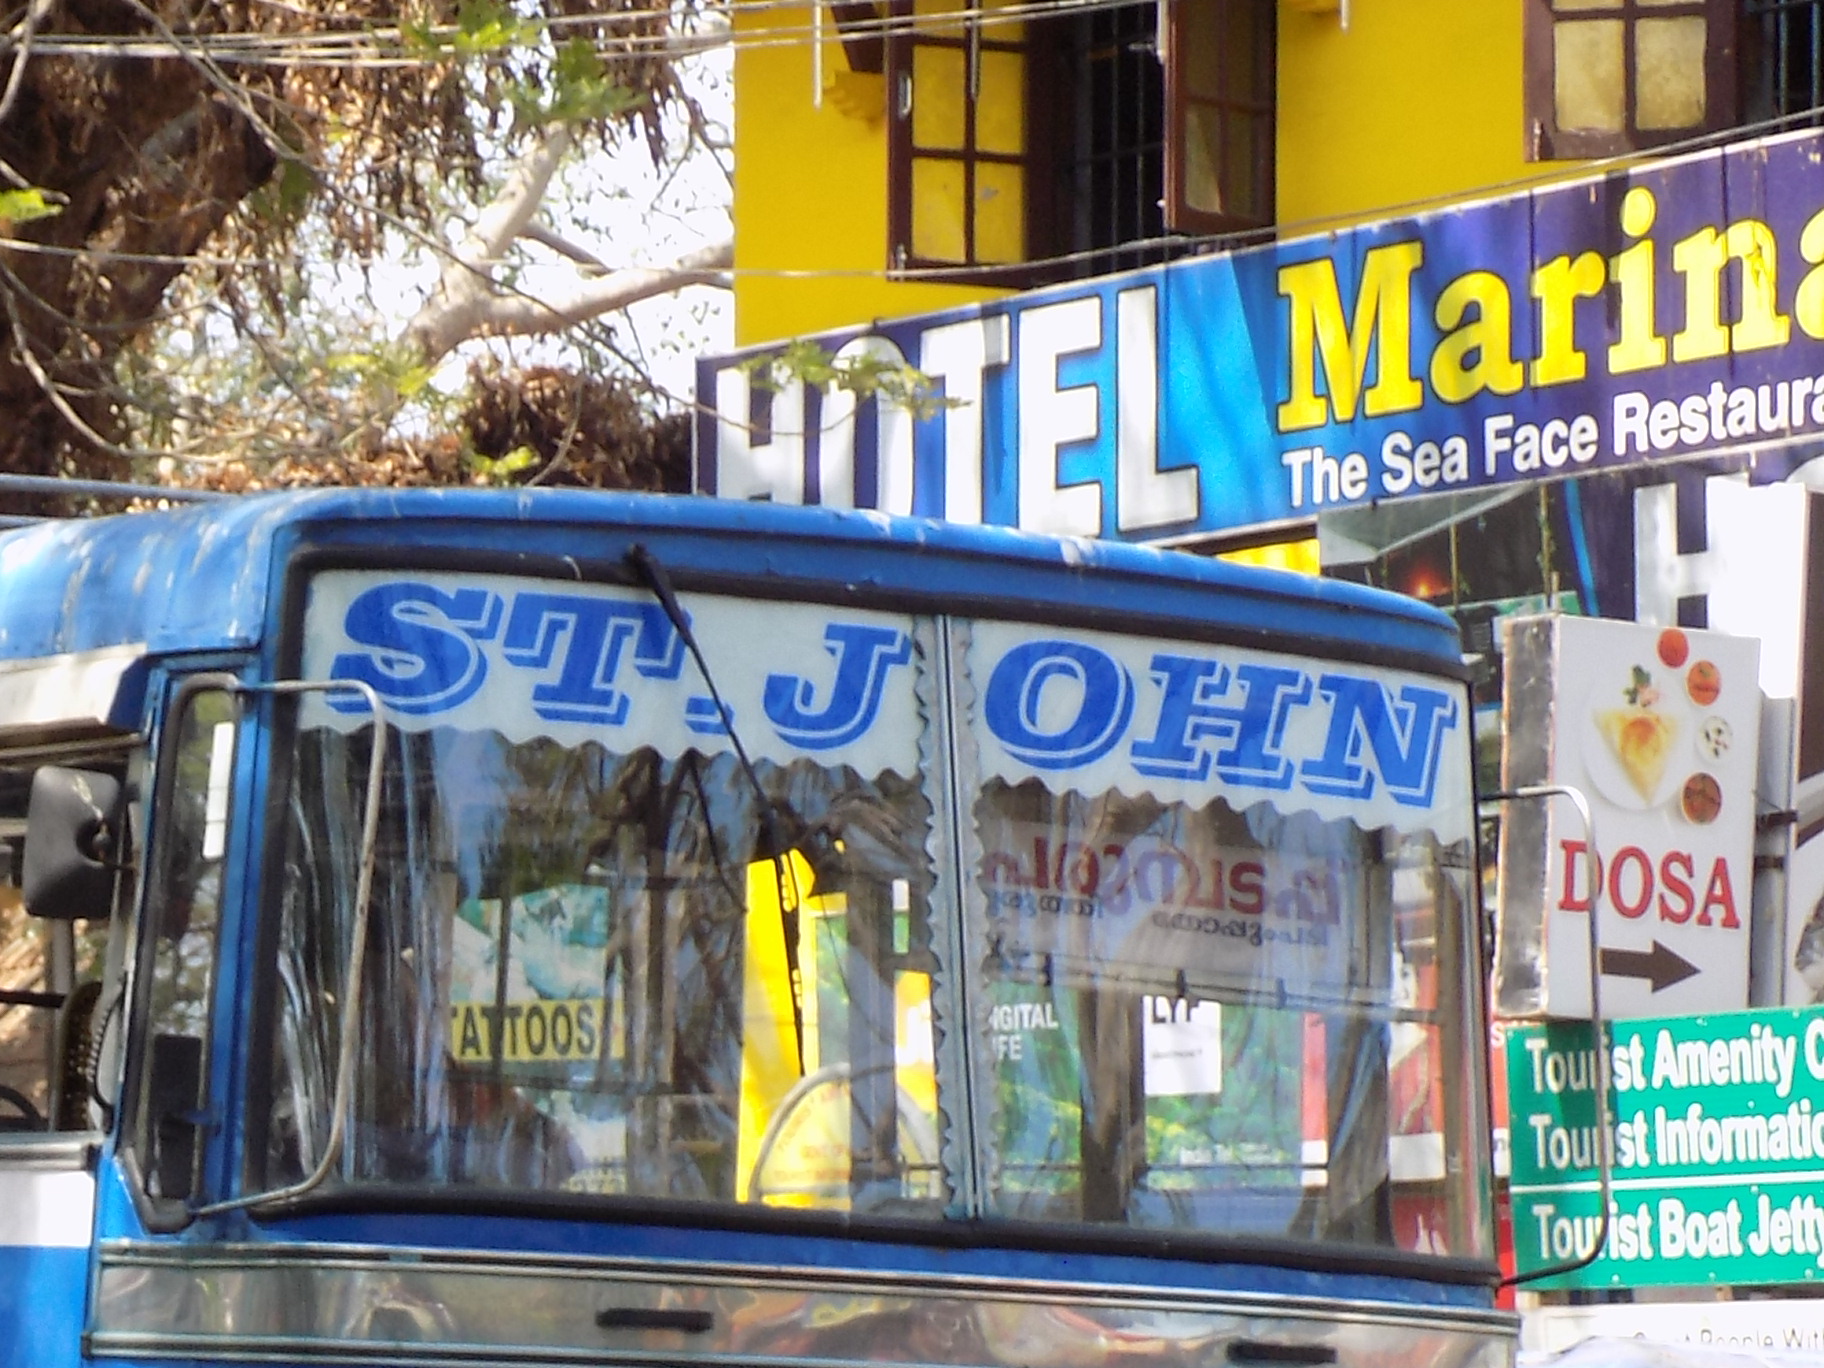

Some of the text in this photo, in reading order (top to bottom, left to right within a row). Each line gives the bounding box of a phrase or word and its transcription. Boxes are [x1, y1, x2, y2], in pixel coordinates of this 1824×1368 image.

[716, 285, 1200, 538] HOTEL
[1281, 446, 1368, 508] The
[1380, 431, 1468, 494] Sea
[1484, 413, 1599, 476] Face
[1558, 839, 1741, 929] DOSA
[1525, 1033, 1647, 1093] Tourist
[1651, 1023, 1797, 1097] Amenity
[1528, 1110, 1651, 1169] Tourist
[1658, 1196, 1743, 1259] Boat
